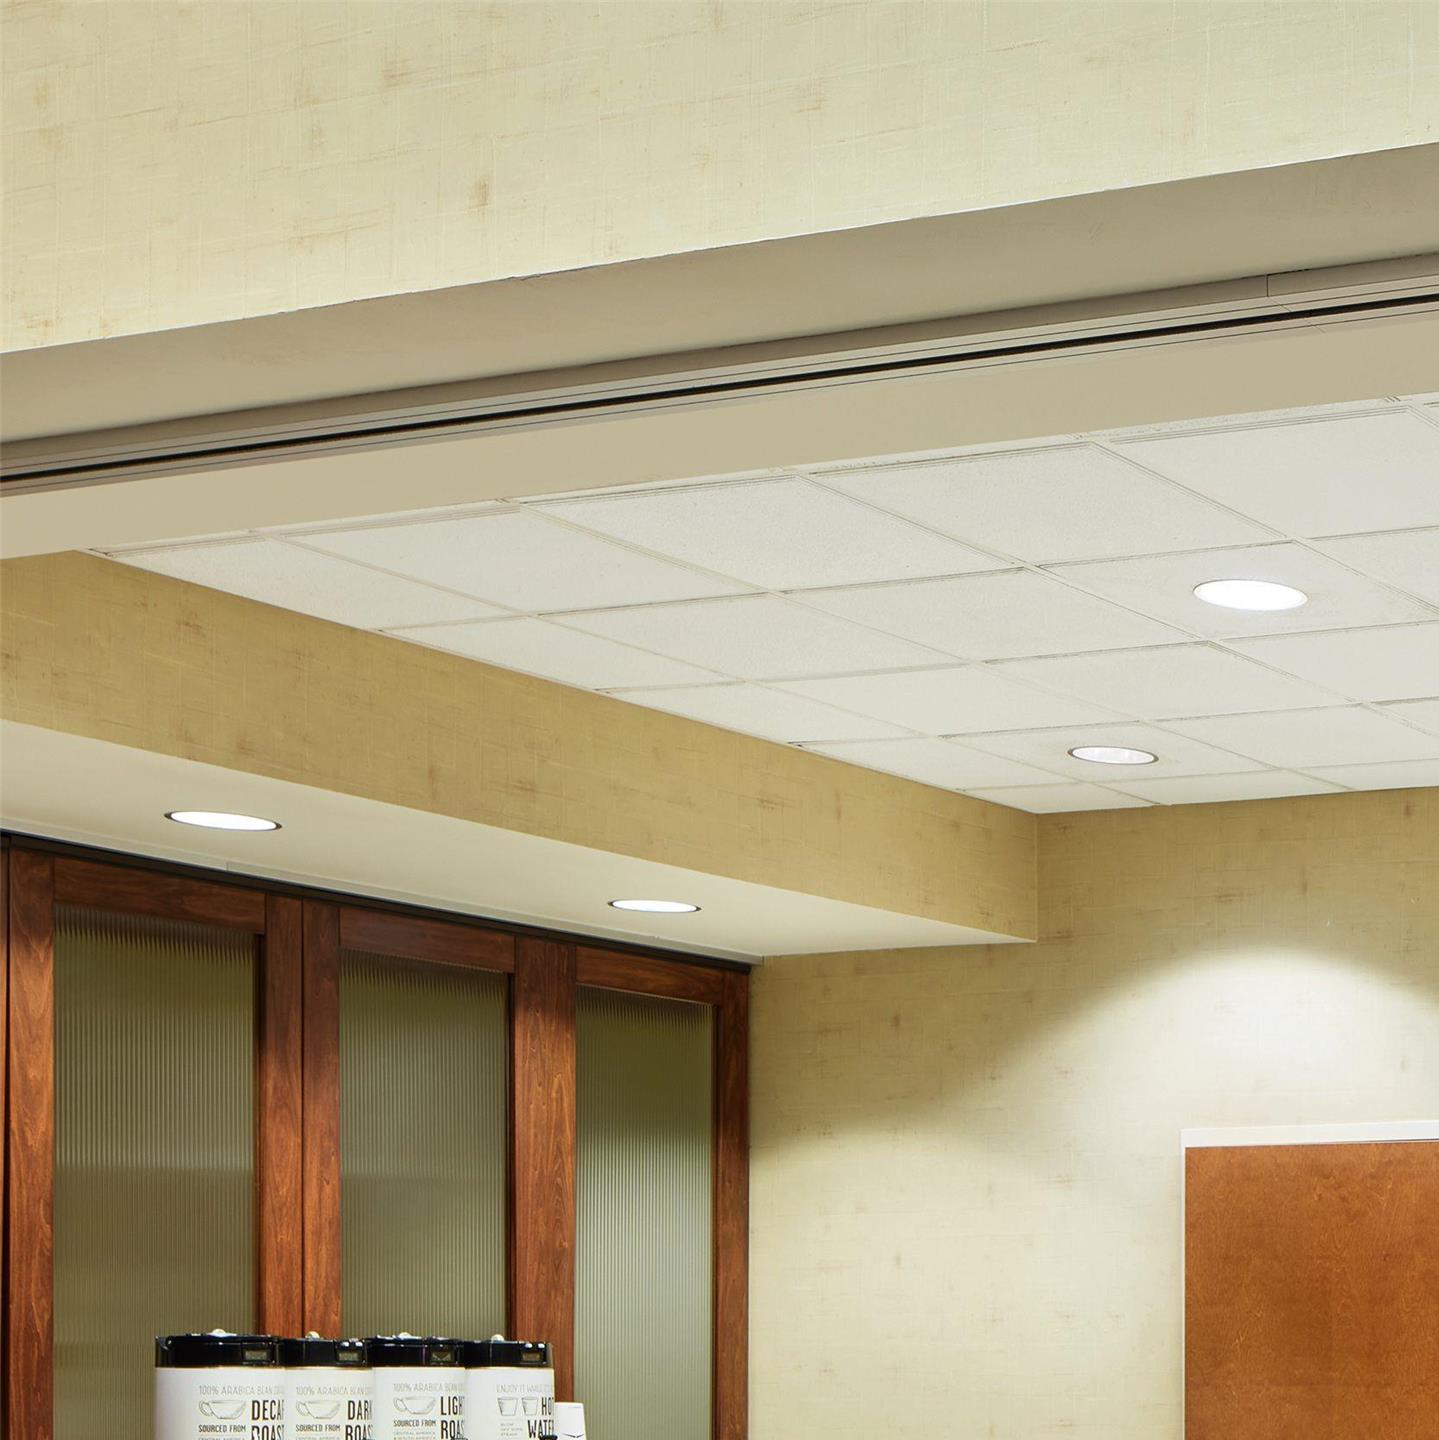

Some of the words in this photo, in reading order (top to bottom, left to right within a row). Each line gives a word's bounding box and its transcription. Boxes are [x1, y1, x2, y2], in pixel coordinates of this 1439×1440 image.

[198, 1424, 228, 1433] SOURCED
[229, 1424, 246, 1433] FROM
[296, 1424, 325, 1433] SOURCED
[327, 1424, 340, 1433] FROM
[393, 1420, 420, 1428] SOURCED
